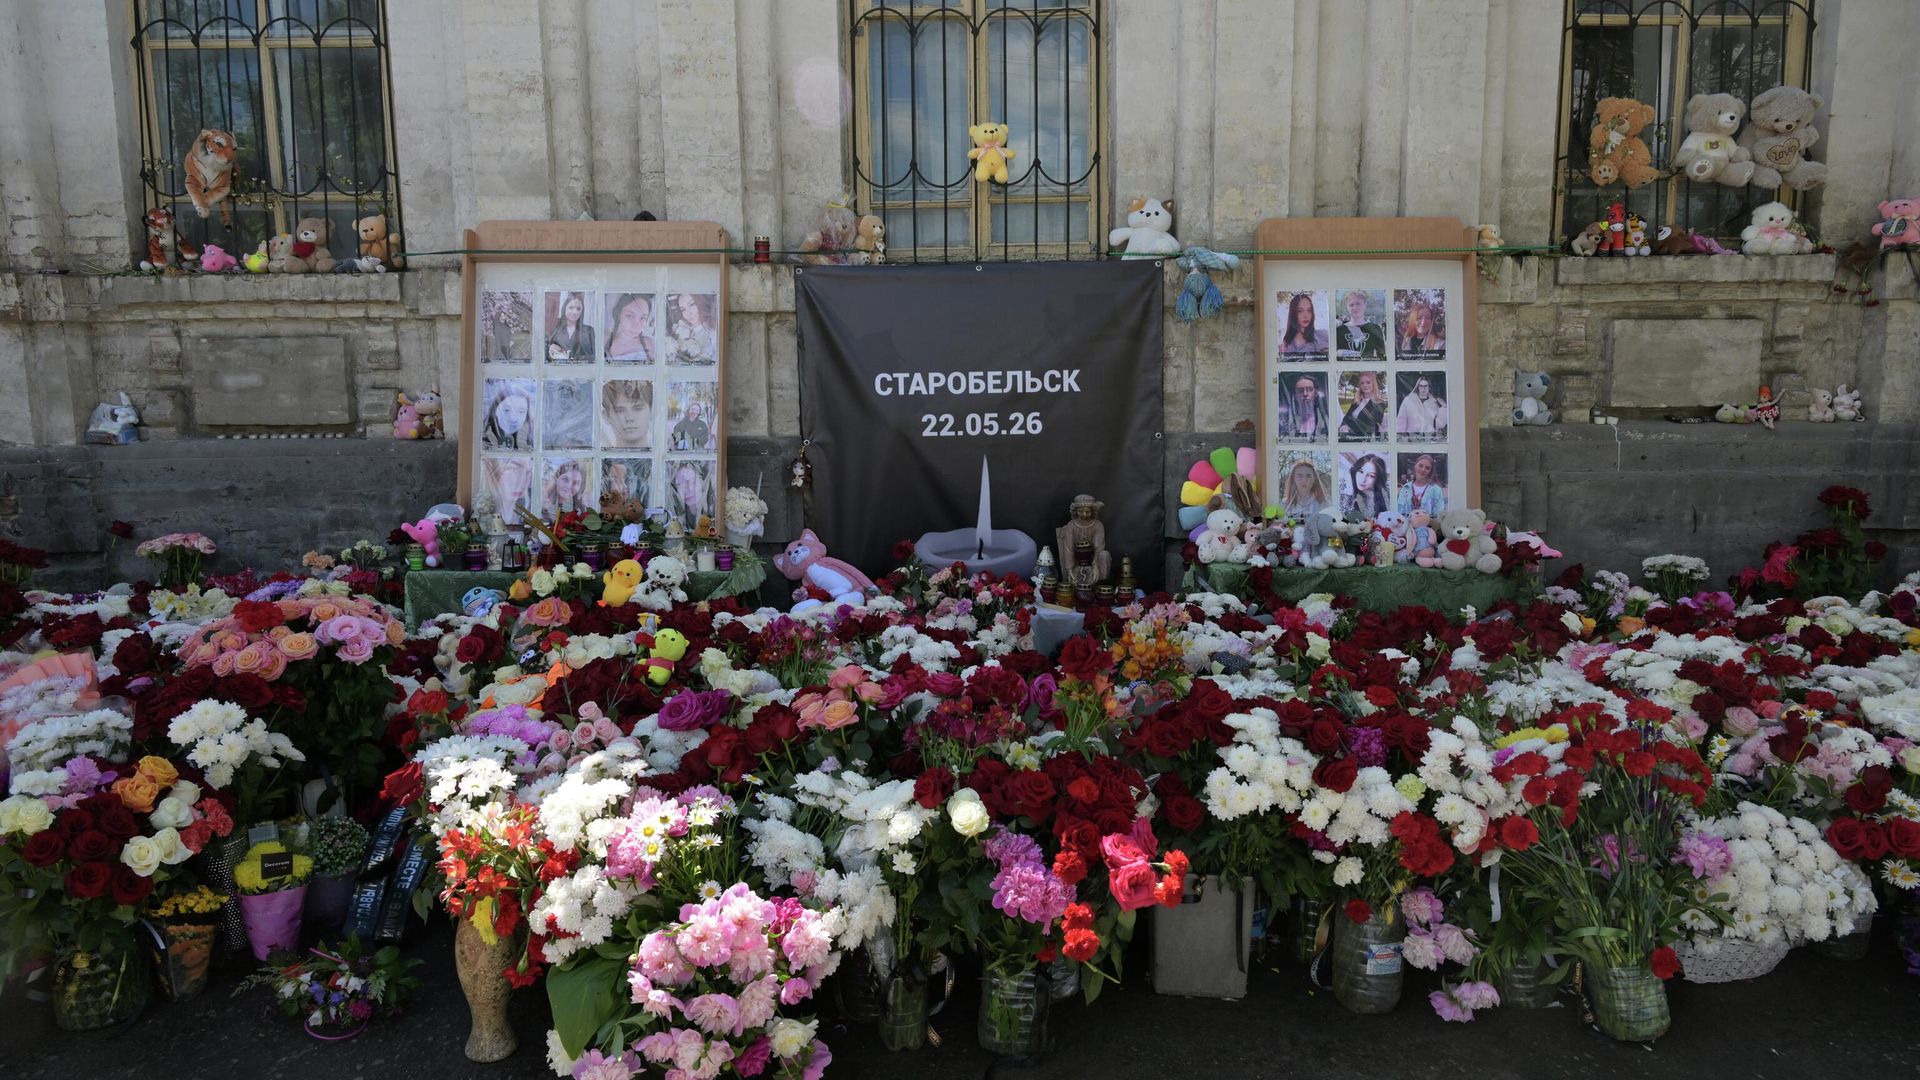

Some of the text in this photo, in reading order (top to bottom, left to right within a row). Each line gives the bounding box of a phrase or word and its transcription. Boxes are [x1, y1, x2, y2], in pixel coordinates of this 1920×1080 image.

[874, 369, 1081, 396] СТАРОБЕЛЬСК
[921, 412, 1043, 437] 22.05.26
[397, 845, 425, 889] ВМЕСТЕ
